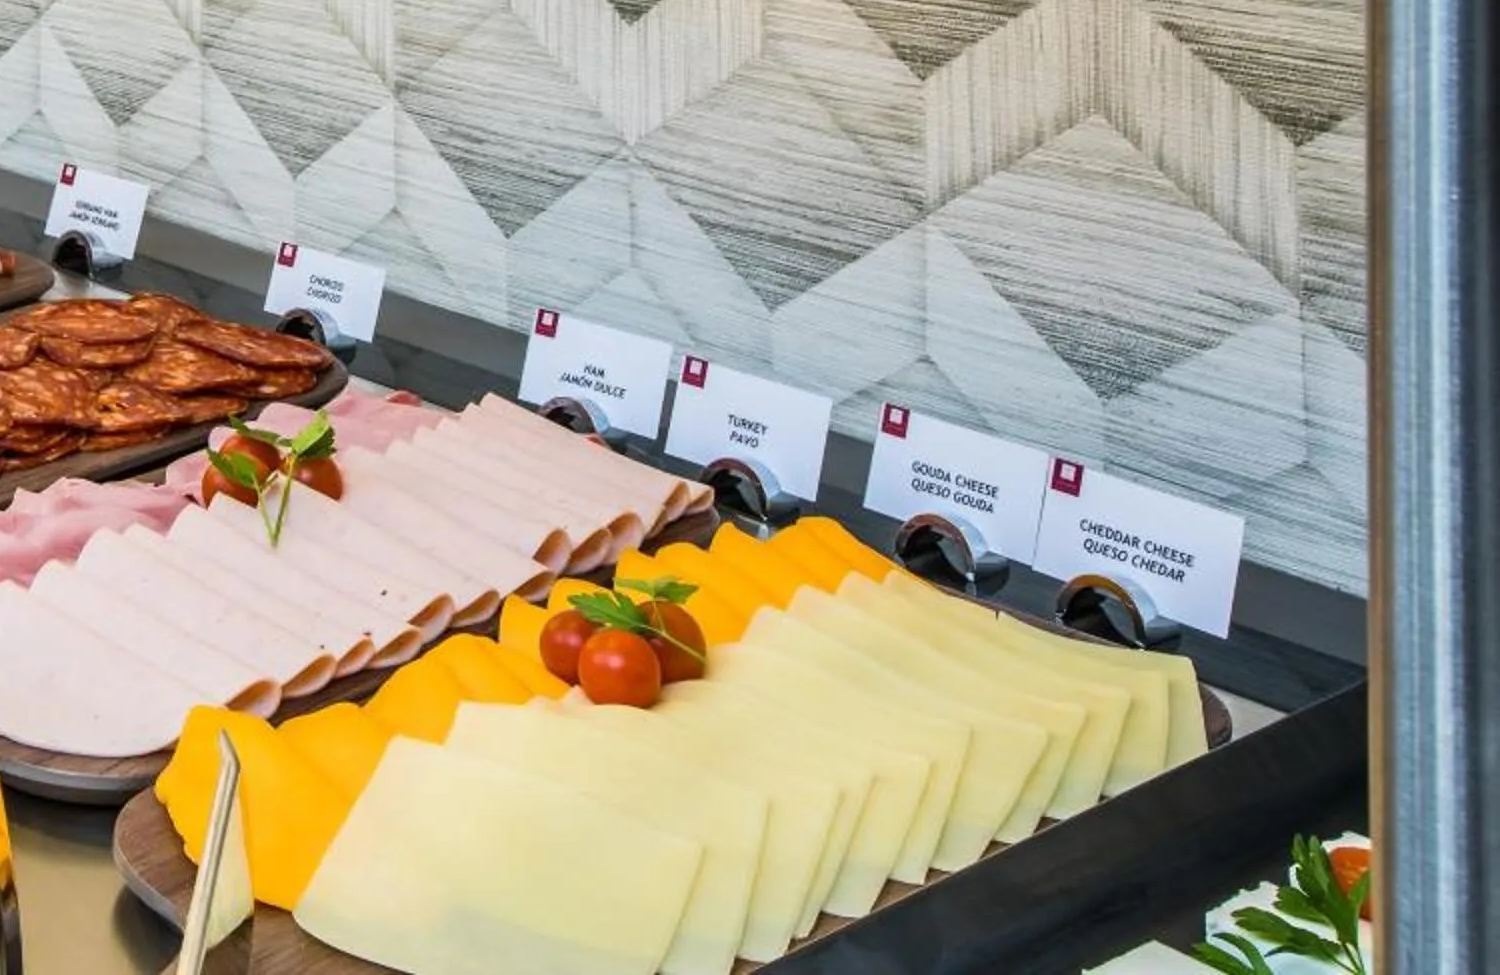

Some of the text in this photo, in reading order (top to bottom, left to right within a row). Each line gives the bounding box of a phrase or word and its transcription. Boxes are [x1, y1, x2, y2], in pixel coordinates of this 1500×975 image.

[584, 364, 605, 379] HAM
[593, 381, 627, 400] DULCE
[728, 414, 769, 436] TURKEY
[729, 430, 759, 448] PAVO
[911, 460, 999, 499] GOUDA CHEESE
[911, 478, 994, 513] QUESO GOUDA
[1079, 518, 1196, 568] CHEDDAR CHEESE
[1083, 538, 1185, 583] QUESO CHEDAR
